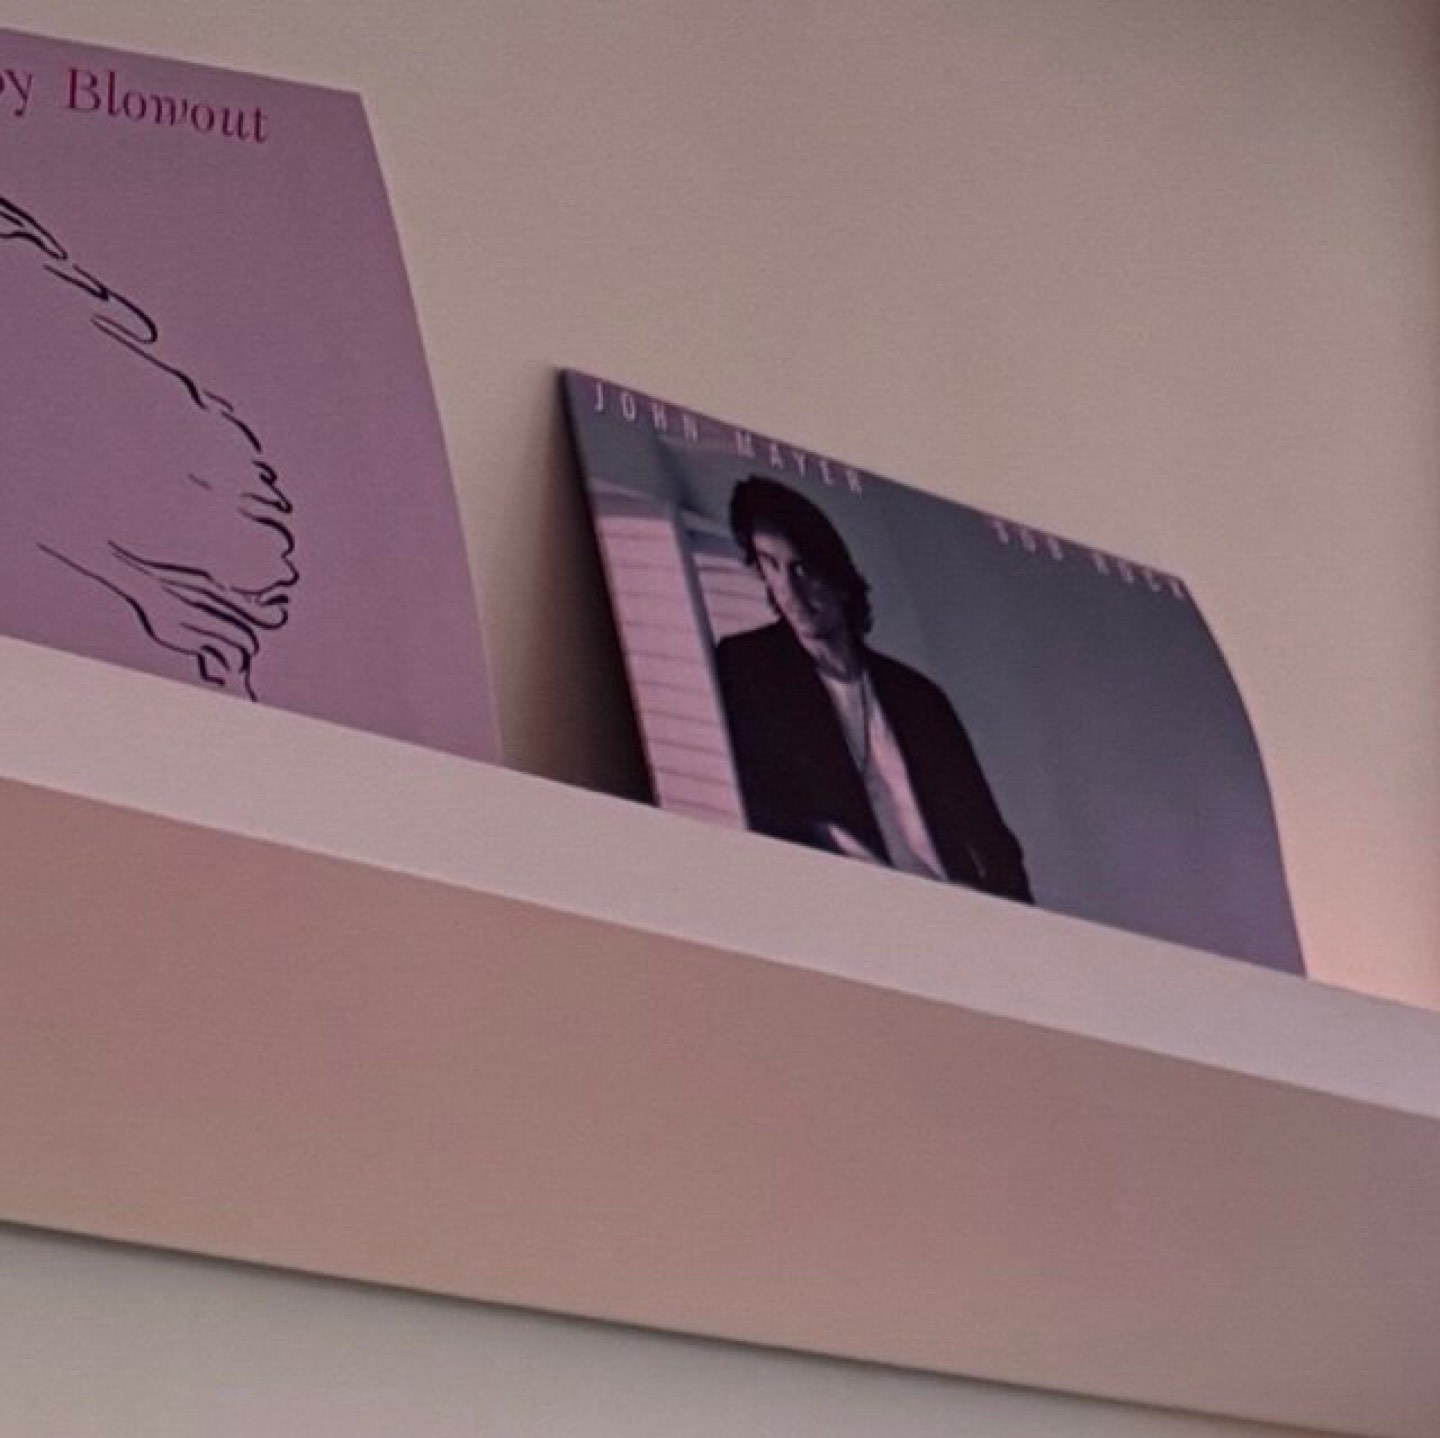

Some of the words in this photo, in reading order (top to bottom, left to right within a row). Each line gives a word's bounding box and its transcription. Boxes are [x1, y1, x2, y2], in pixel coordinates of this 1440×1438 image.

[66, 66, 270, 144] Blowout
[593, 382, 702, 444] JOHN
[734, 430, 867, 496] MAYER
